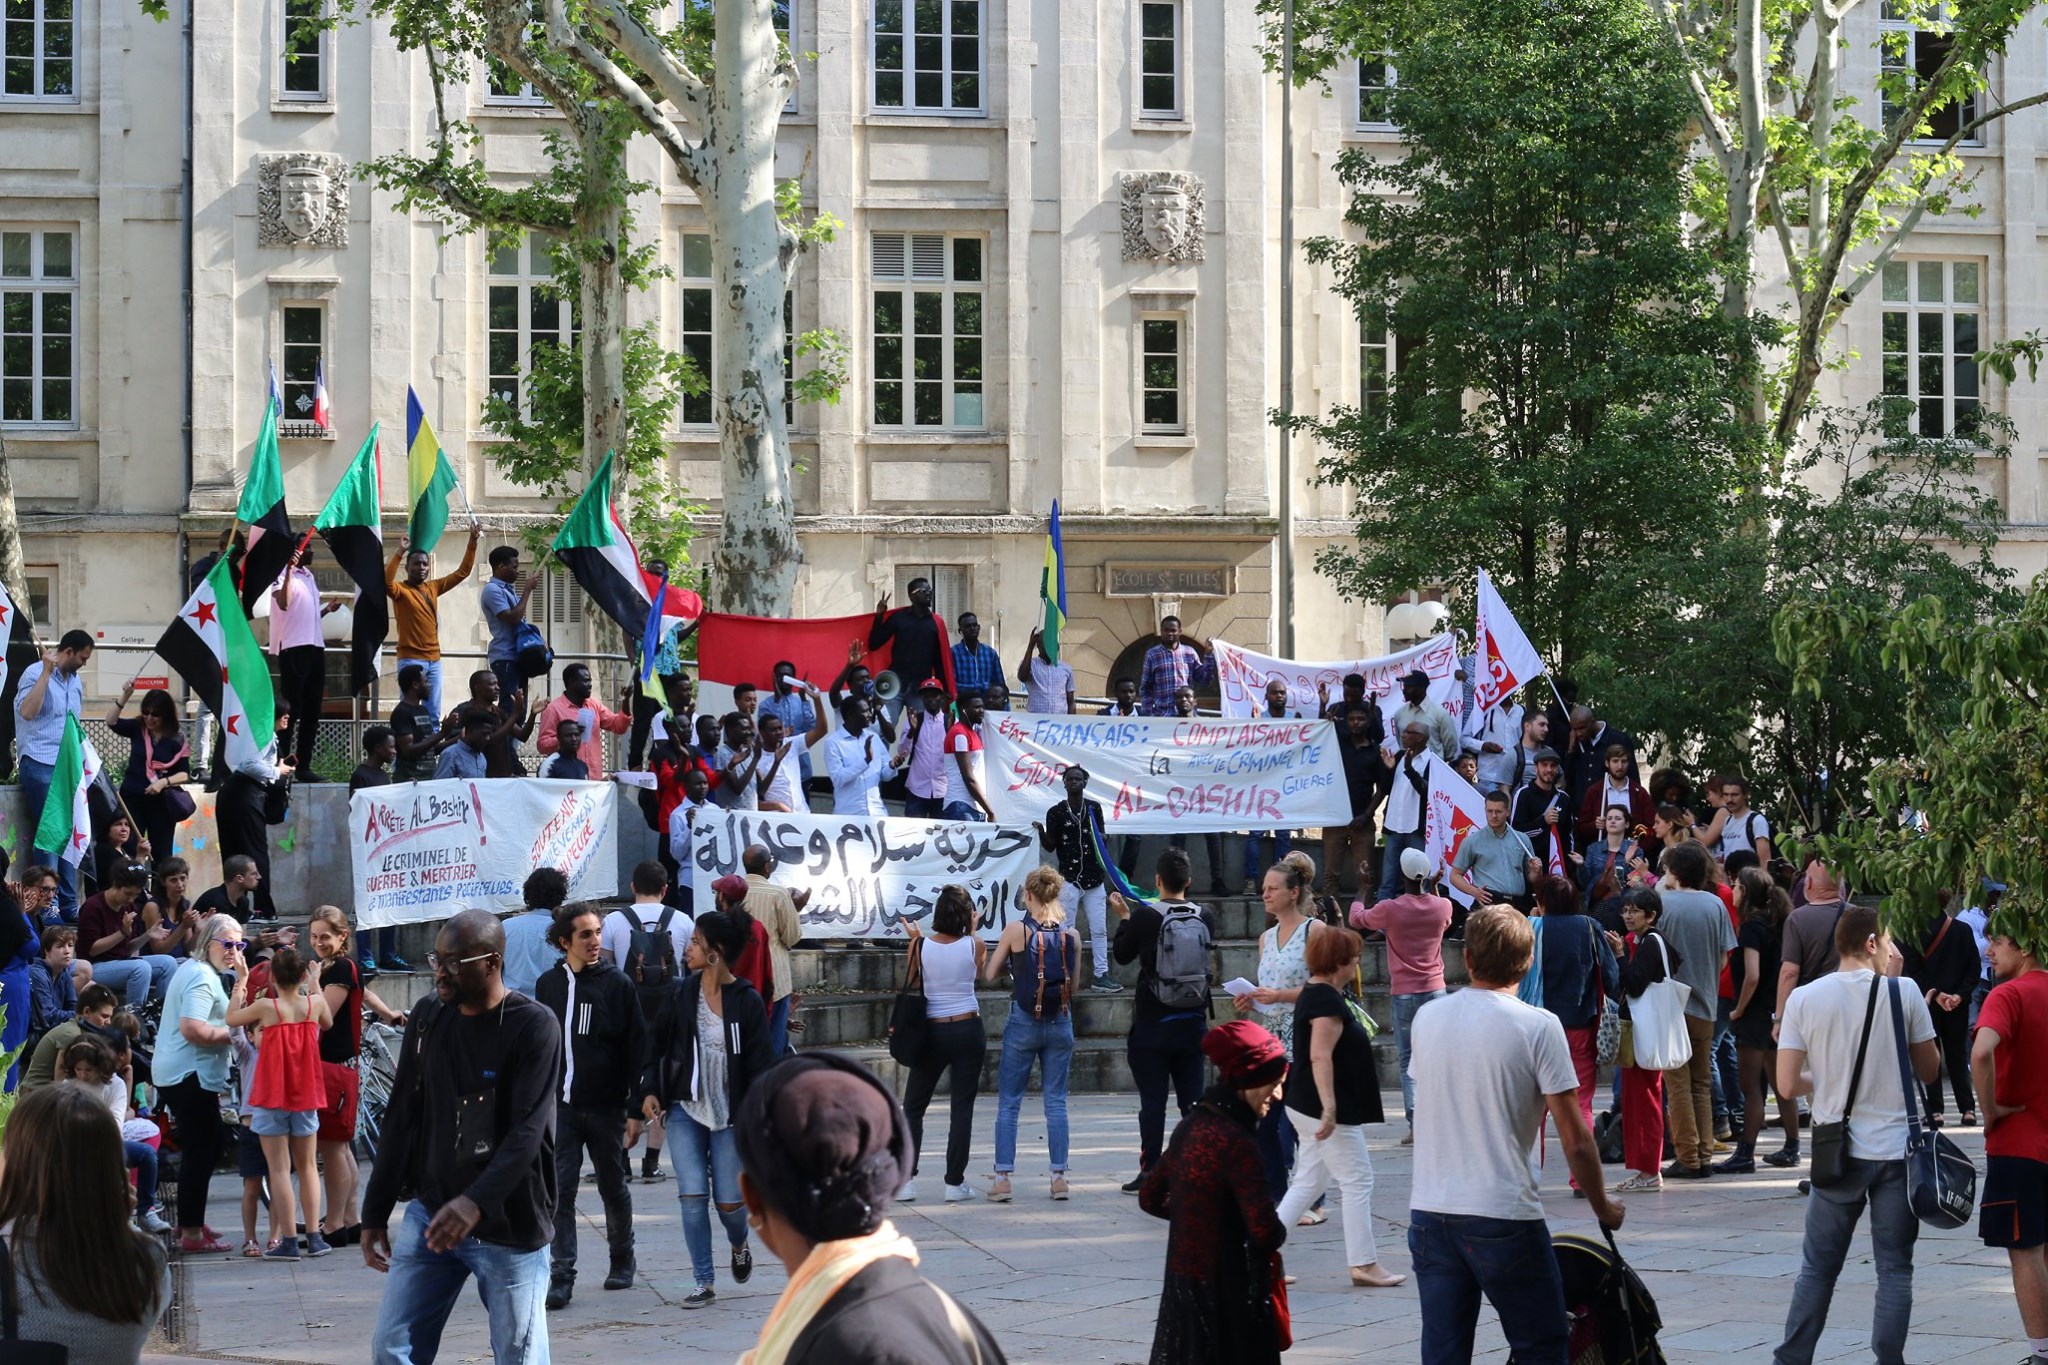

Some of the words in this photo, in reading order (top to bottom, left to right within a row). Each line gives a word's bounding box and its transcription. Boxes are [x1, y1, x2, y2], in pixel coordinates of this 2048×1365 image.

[1178, 572, 1219, 587] FILLES
[1173, 721, 1314, 748] COMPLAISANCE
[1188, 752, 1216, 768] AVEC
[1213, 757, 1226, 774] LE
[1227, 750, 1294, 775] CRIMINEL
[1299, 744, 1322, 765] DE
[1282, 772, 1334, 796] GUERRE
[1112, 781, 1284, 821] AL-BASHIR
[382, 854, 392, 872] LE
[393, 848, 451, 871] CRIMINEL
[455, 846, 468, 863] DE
[366, 872, 406, 893] GUERRE
[410, 871, 418, 887] &
[421, 863, 477, 885] MERTRIER
